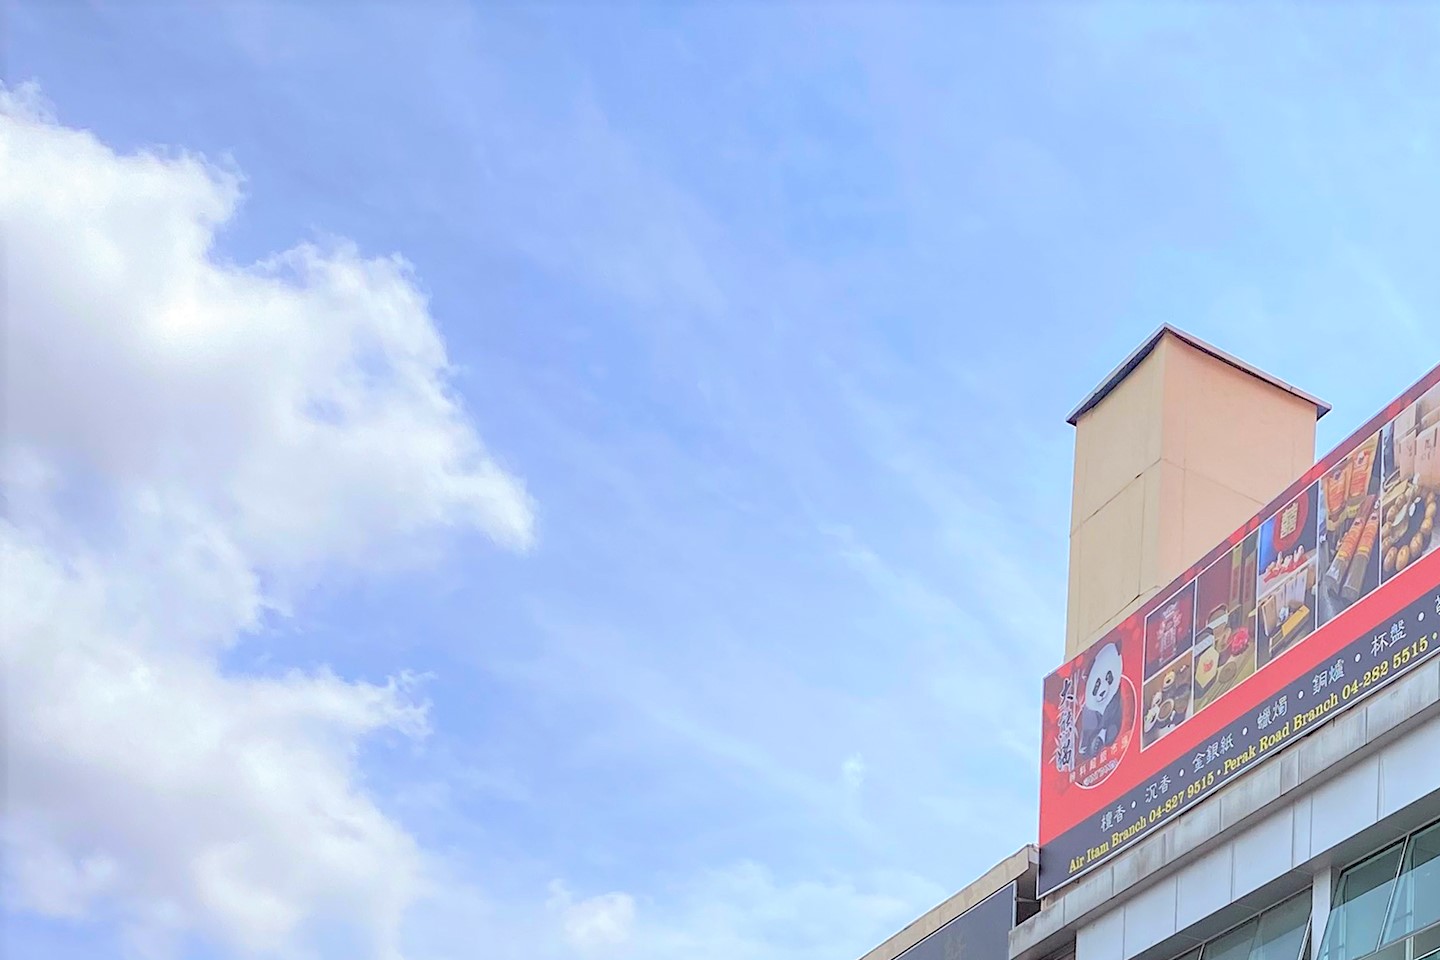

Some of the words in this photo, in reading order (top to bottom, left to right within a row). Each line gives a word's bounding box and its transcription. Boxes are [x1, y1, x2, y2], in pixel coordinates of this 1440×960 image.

[1069, 857, 1084, 873] Air
[1086, 841, 1110, 864] Itam
[1111, 816, 1147, 848] Branch
[1149, 790, 1186, 823] 04-827
[1187, 772, 1215, 800] 9515
[1223, 746, 1257, 776] Perak
[1259, 727, 1291, 753] Road
[1293, 693, 1339, 733] Branch
[1342, 660, 1389, 700] 04-282
[1392, 635, 1429, 669] 5515
